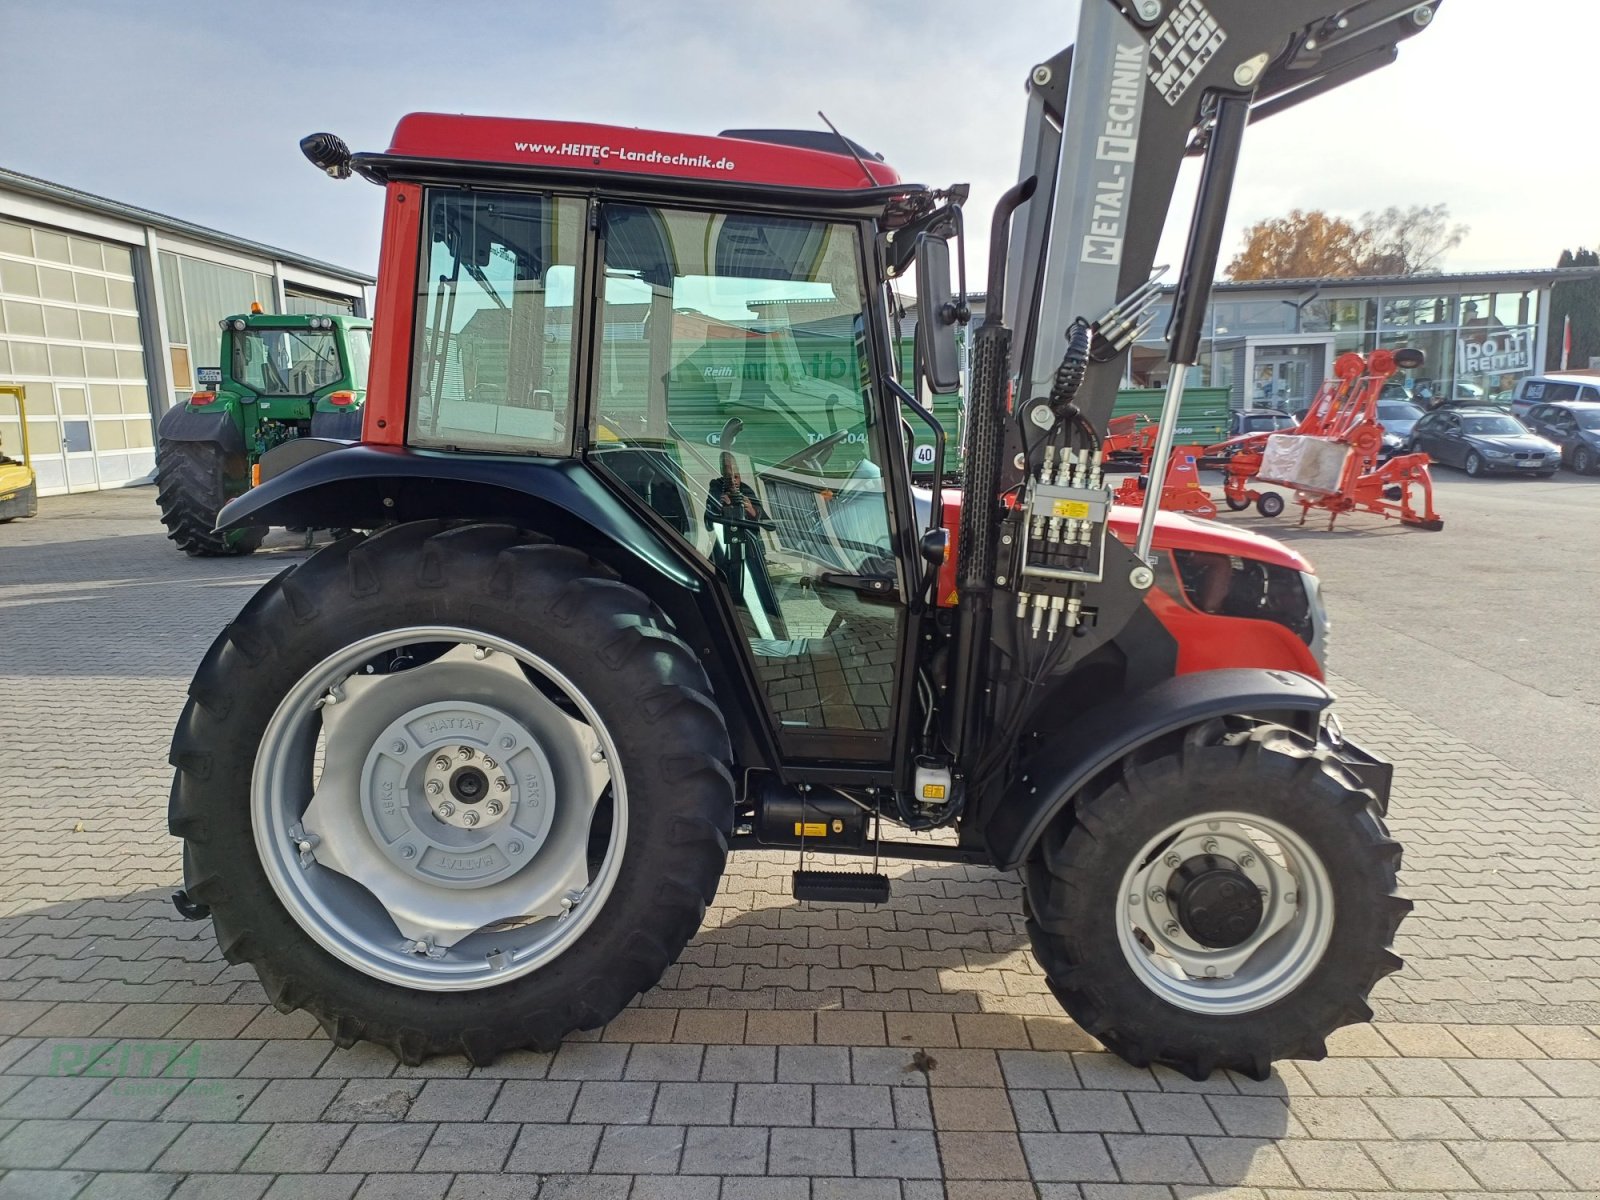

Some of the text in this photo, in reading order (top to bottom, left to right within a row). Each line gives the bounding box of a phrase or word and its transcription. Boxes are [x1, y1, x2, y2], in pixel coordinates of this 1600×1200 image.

[1167, 32, 1222, 102] MINI
[514, 142, 735, 171] www.HEITEC-Landtechnik.de
[1466, 336, 1523, 359] DO IT
[1467, 352, 1525, 372] REITH!
[918, 447, 932, 462] 40
[427, 718, 484, 734] HATTAT
[439, 855, 495, 871] HATTAT
